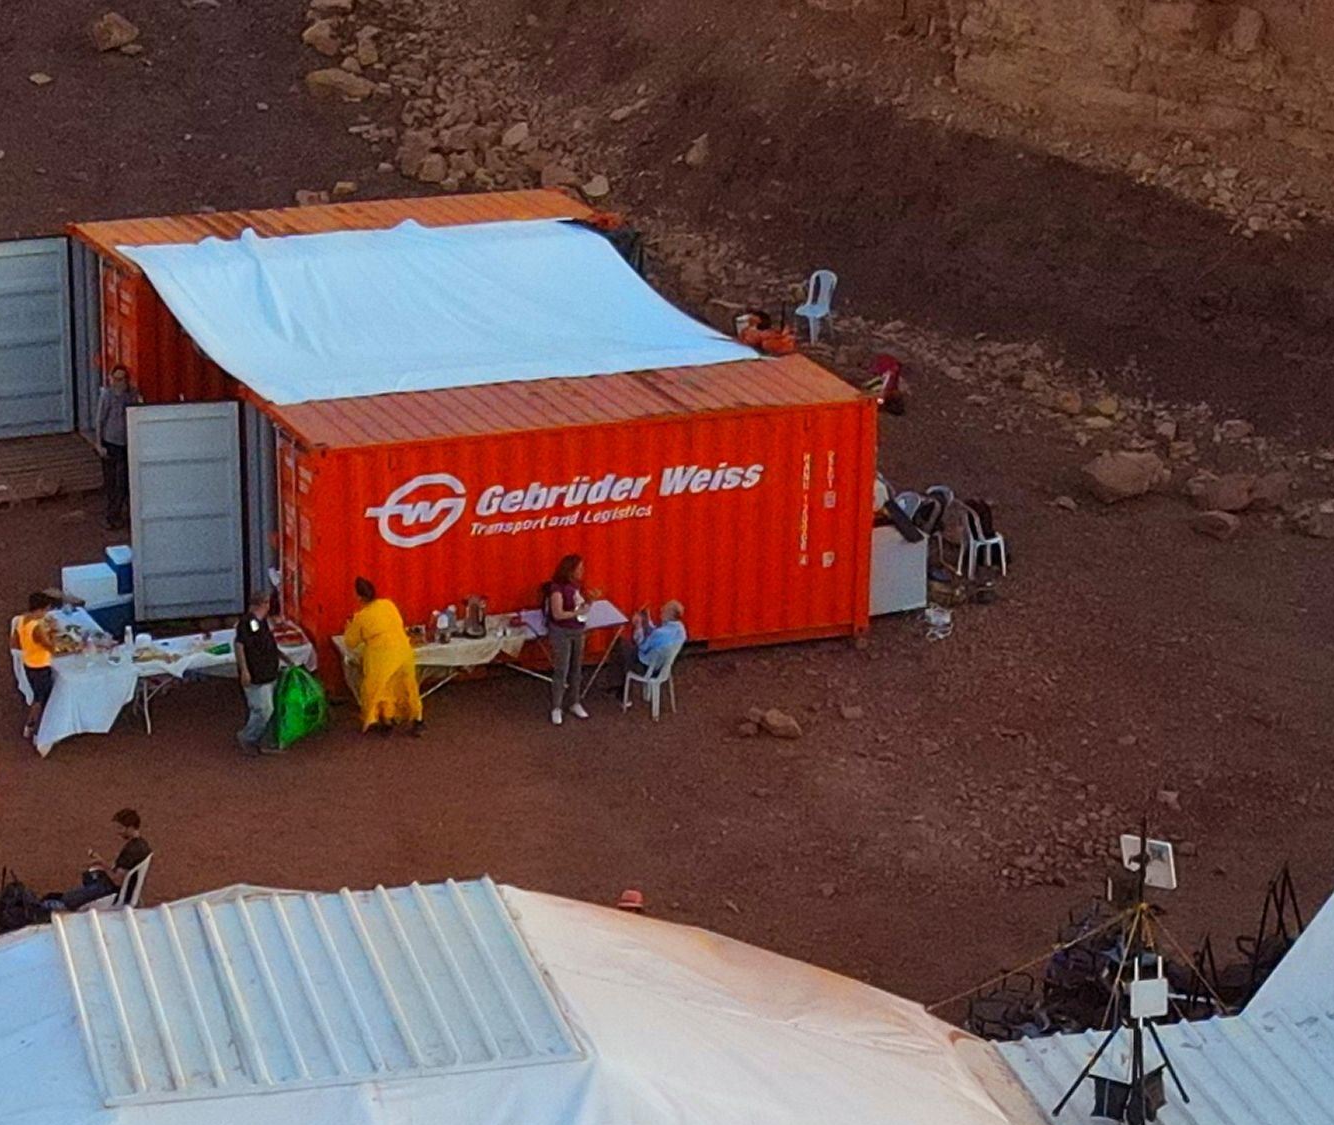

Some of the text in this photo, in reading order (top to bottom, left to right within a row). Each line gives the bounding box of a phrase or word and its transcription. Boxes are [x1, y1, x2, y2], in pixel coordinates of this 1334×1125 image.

[475, 462, 763, 516] Gebrüder Weiss
[470, 504, 653, 536] Transport and Logistics
